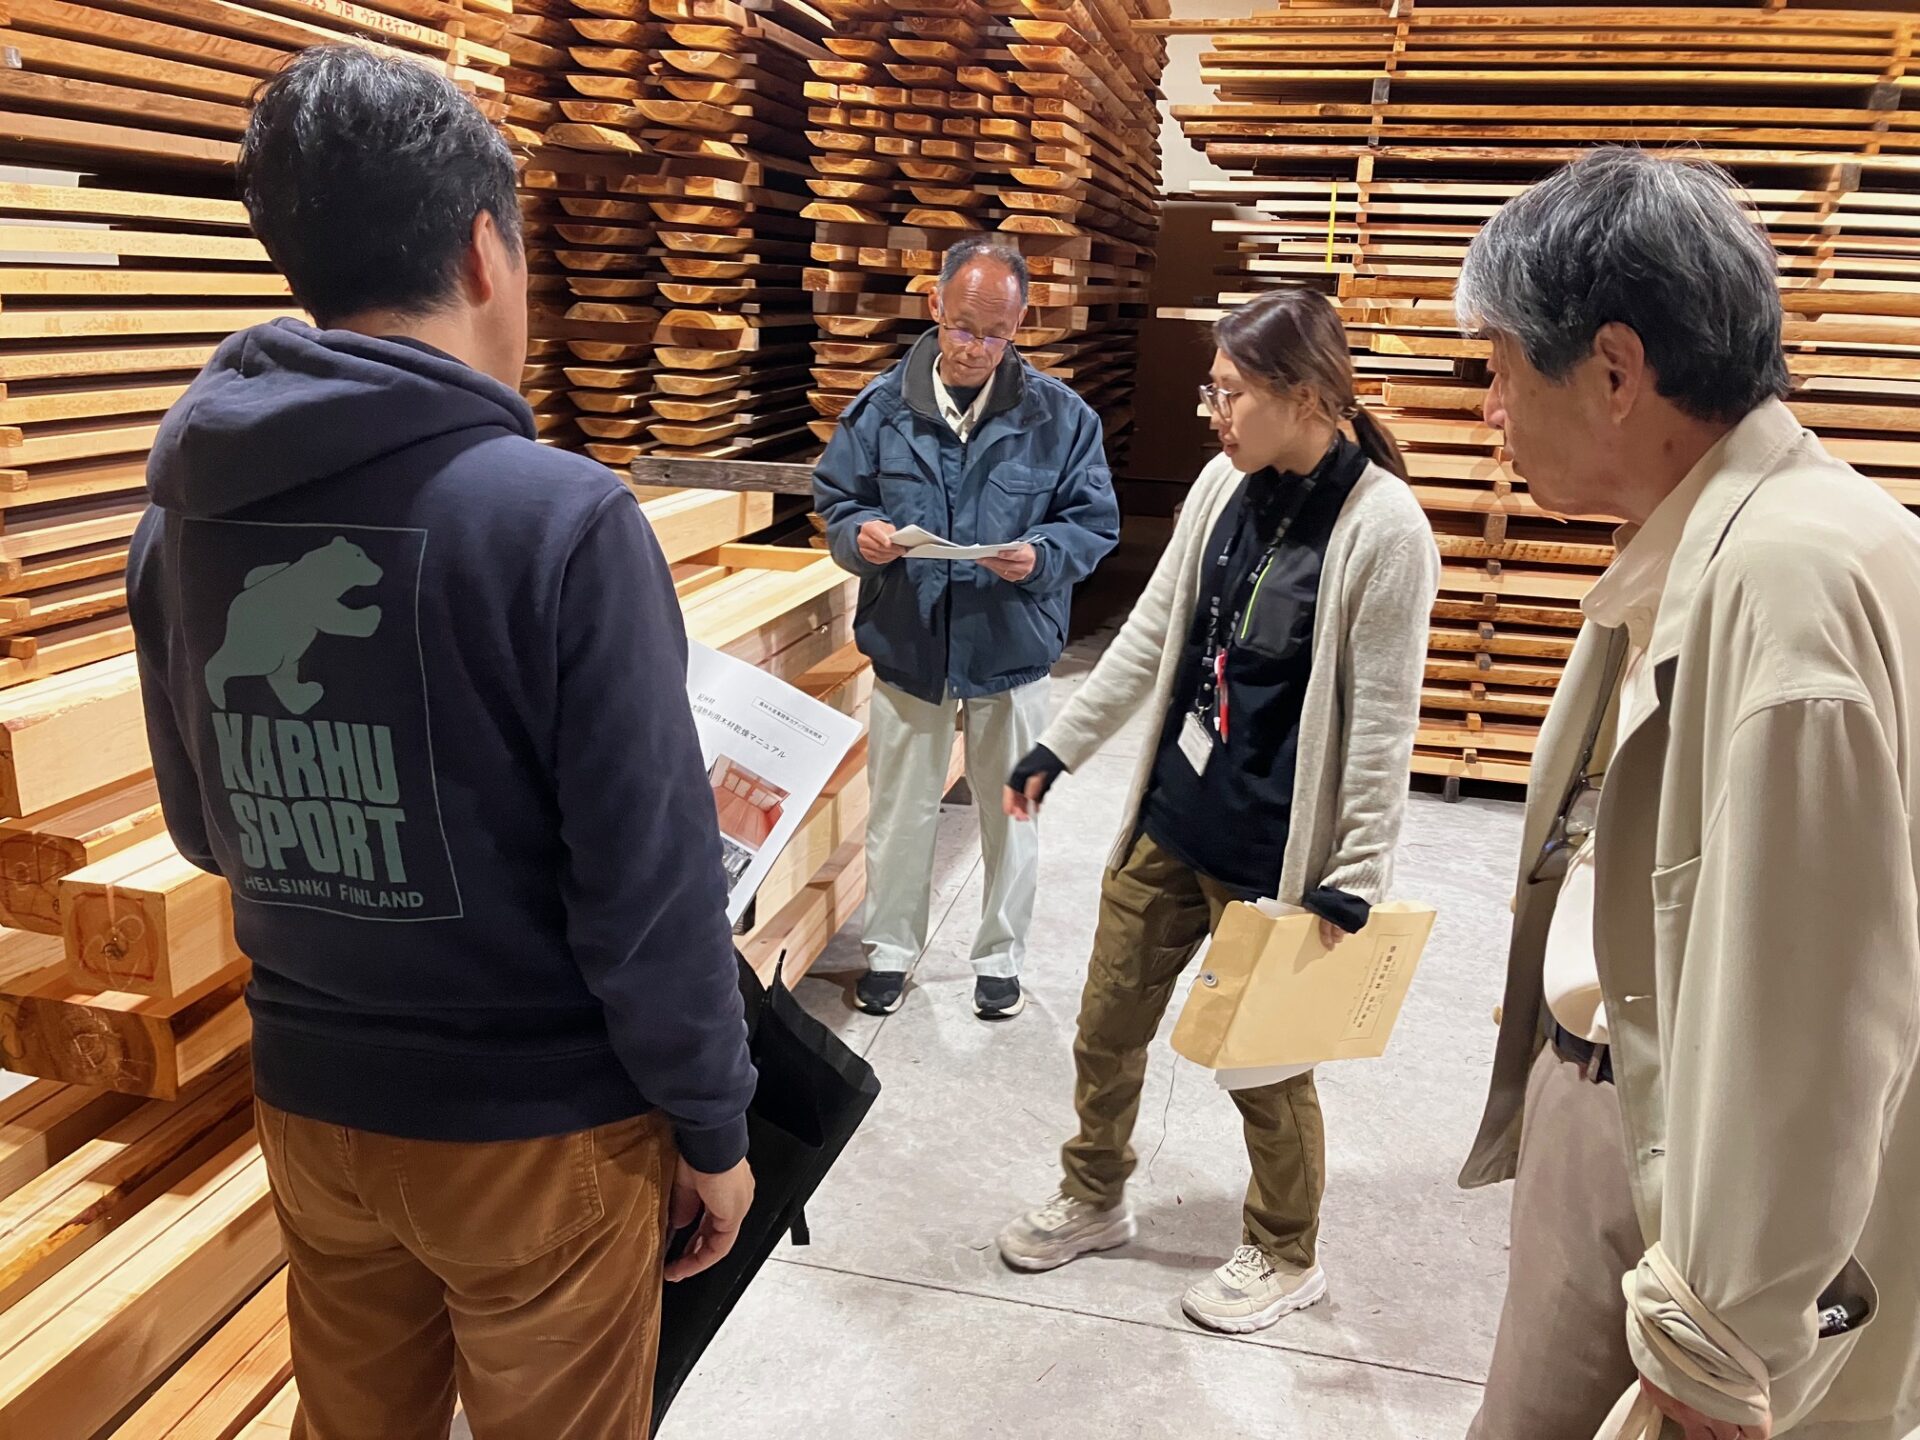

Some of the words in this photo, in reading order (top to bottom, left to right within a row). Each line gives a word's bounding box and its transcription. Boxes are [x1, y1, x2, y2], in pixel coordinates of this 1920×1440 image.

[211, 711, 400, 805] KARHU
[229, 792, 408, 884] SPORT
[244, 876, 330, 898] HELSINKI
[338, 883, 425, 909] FINLAND
